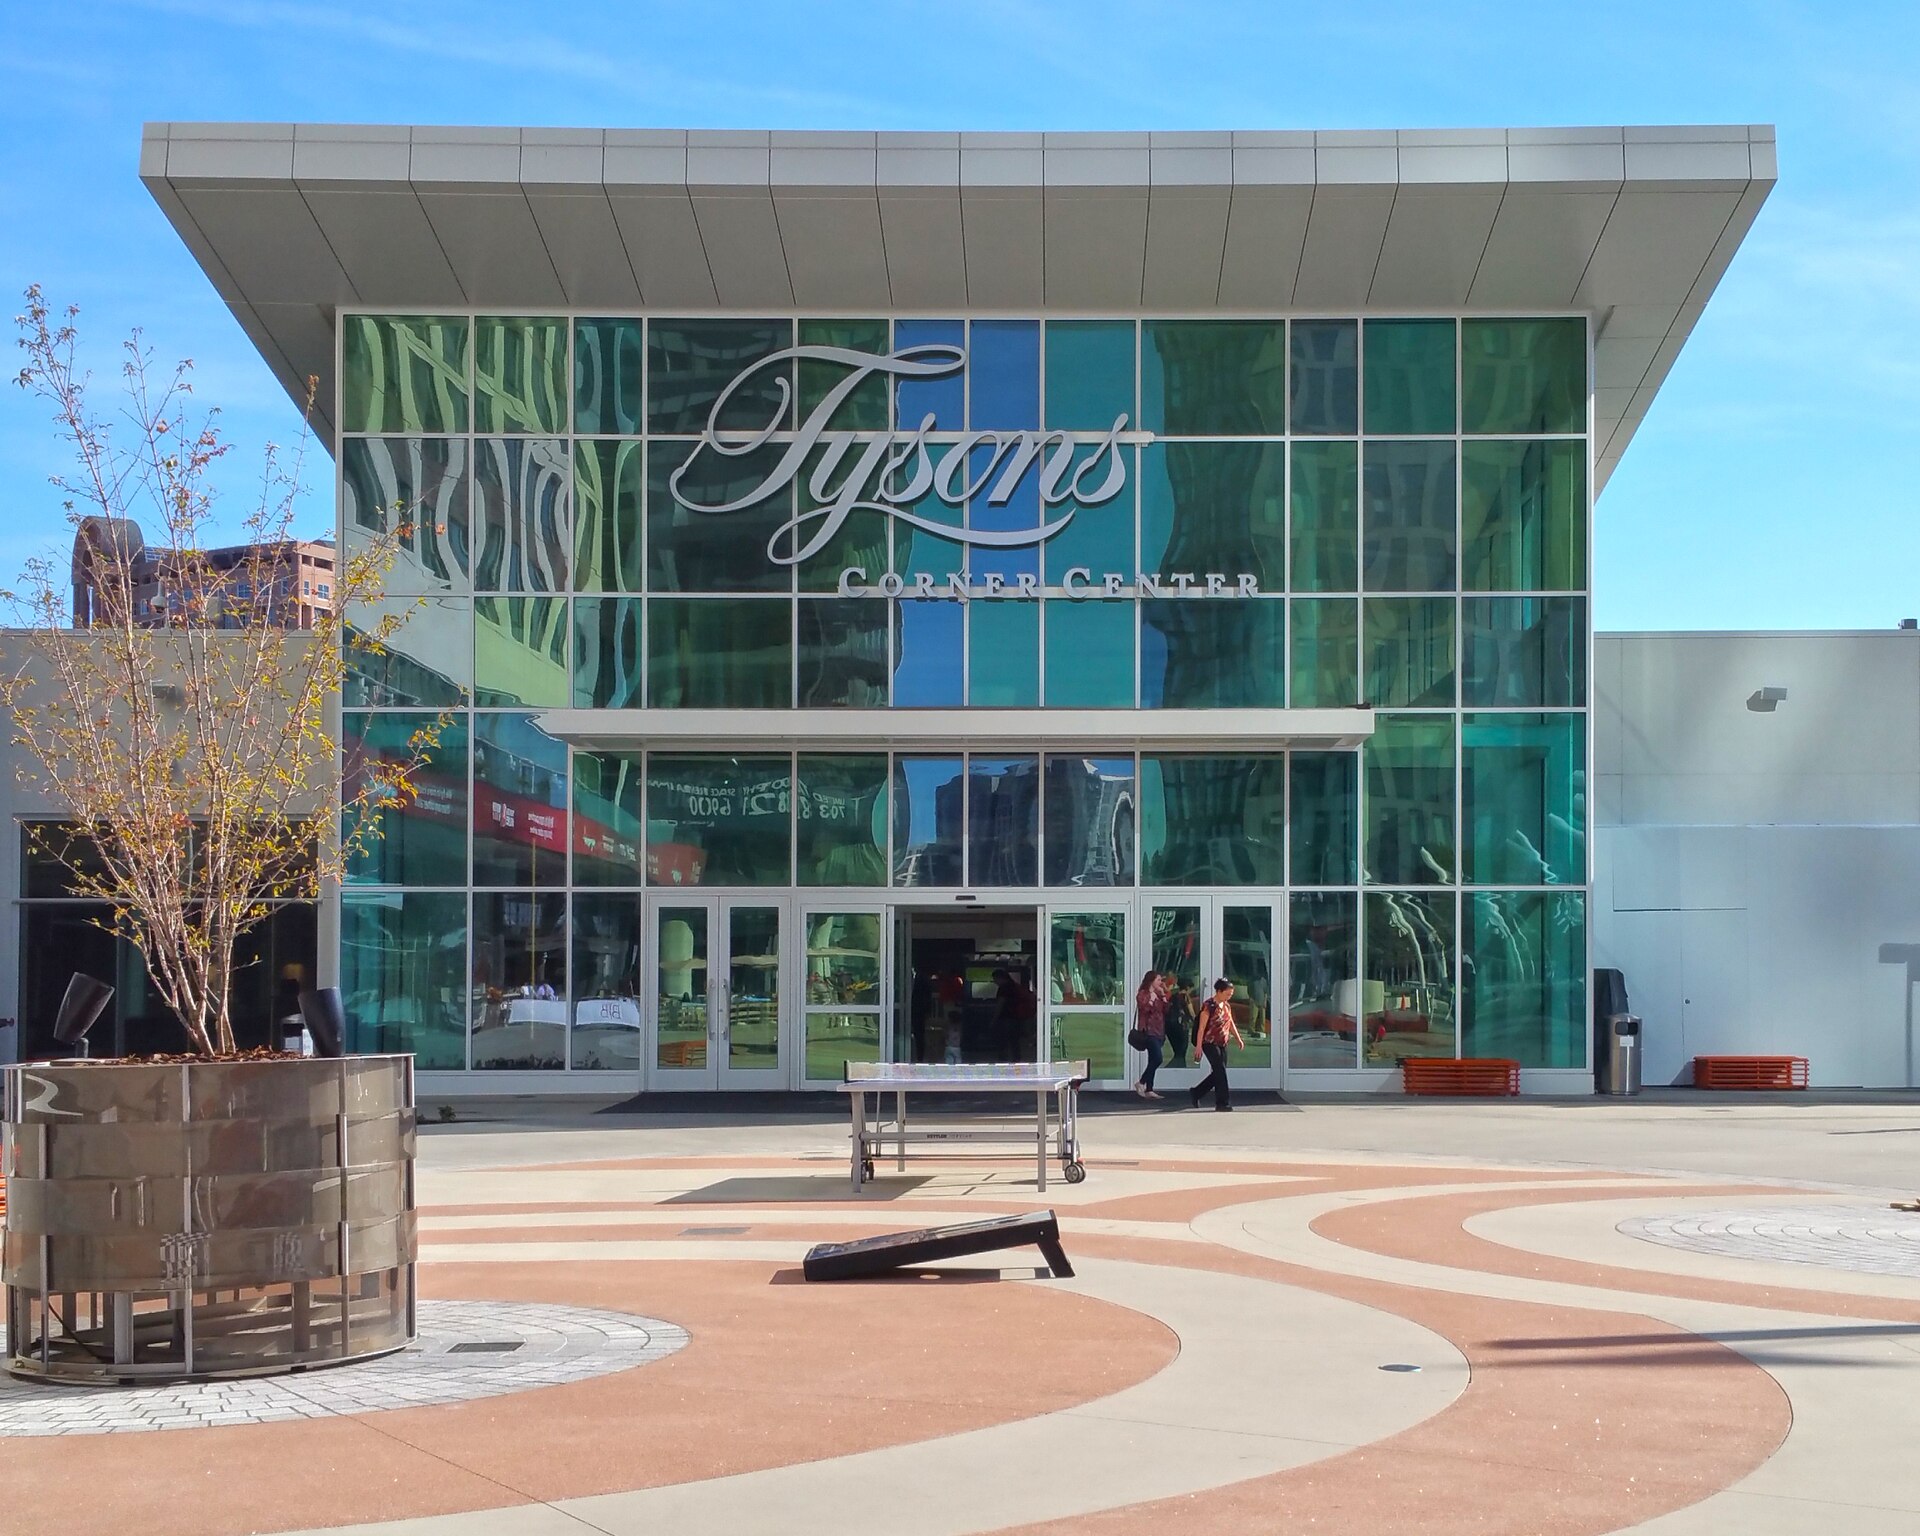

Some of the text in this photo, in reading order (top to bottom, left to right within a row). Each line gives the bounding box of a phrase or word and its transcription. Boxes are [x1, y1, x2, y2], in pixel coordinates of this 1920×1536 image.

[669, 344, 1128, 565] Tysons
[838, 567, 1260, 599] CORNER CENTER
